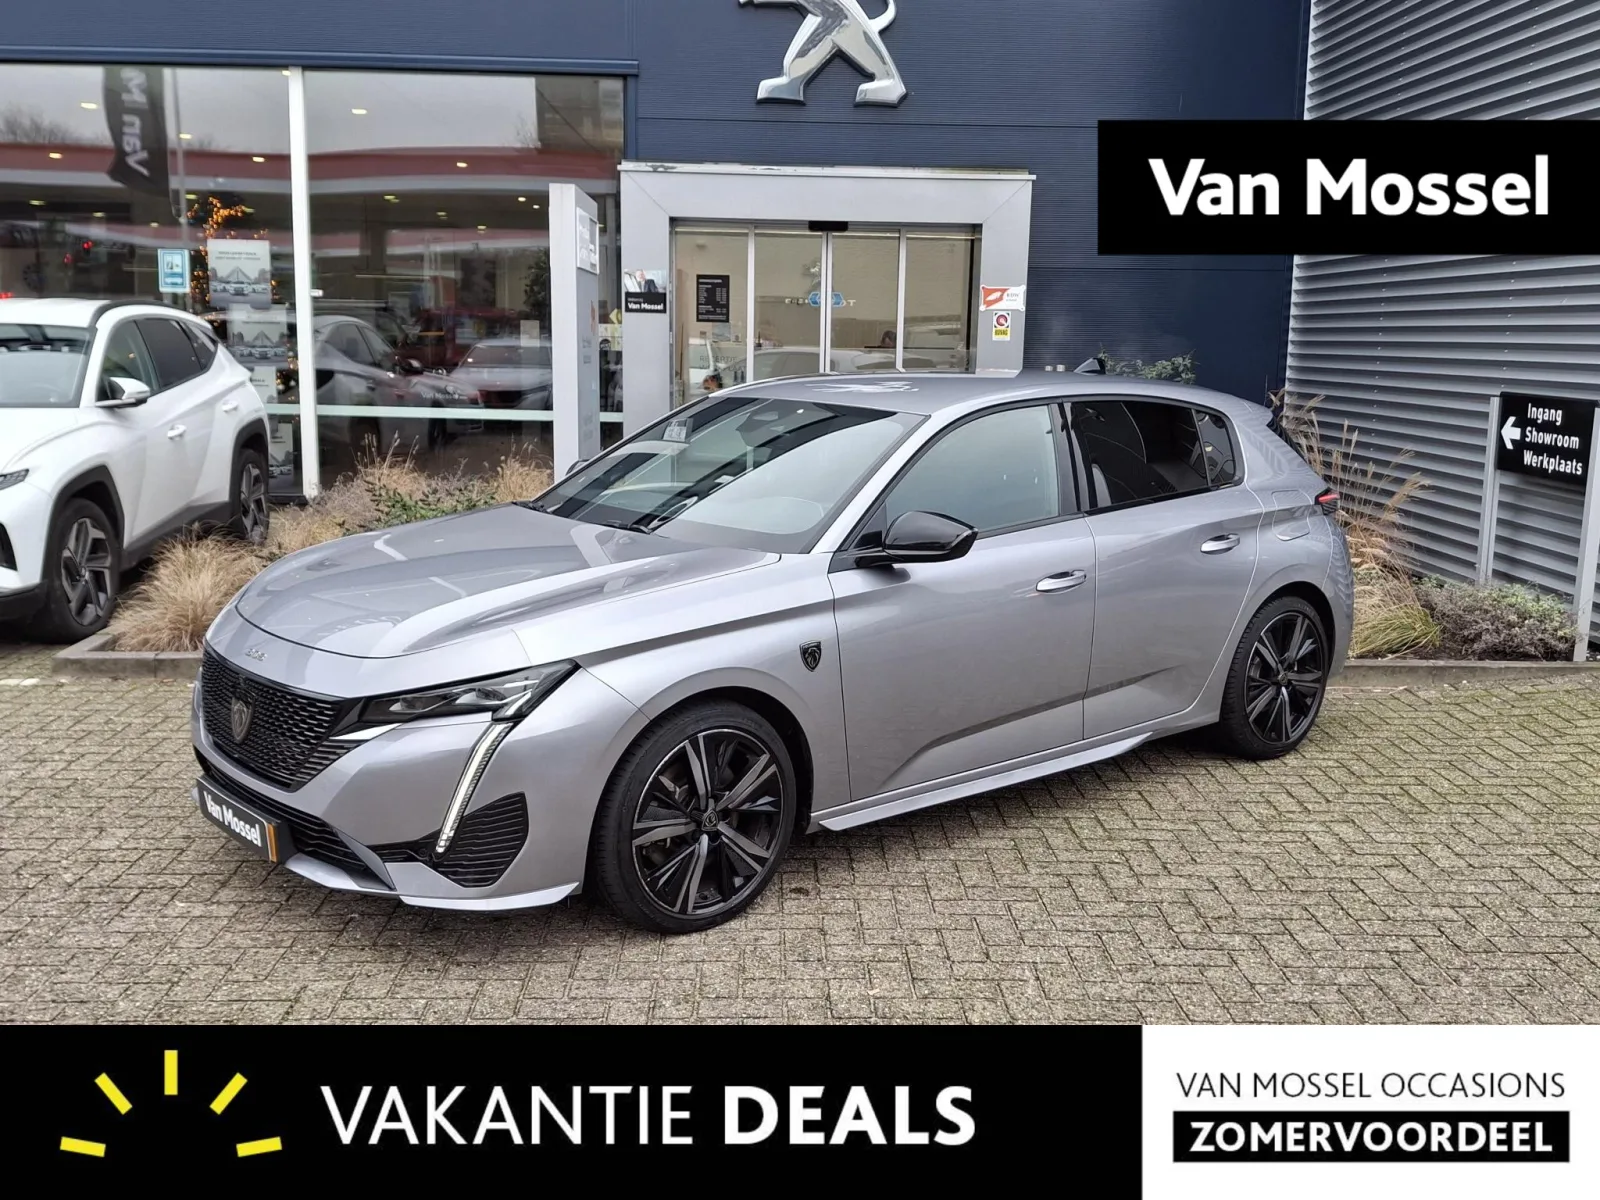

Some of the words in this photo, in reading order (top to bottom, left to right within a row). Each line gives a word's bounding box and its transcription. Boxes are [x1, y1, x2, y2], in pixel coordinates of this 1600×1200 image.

[627, 302, 640, 310] Van
[641, 302, 664, 310] Mossel
[1527, 402, 1563, 426] Ingang
[1524, 426, 1580, 450] Showroom
[1523, 449, 1583, 475] Werkplaats
[203, 791, 223, 822] Van
[222, 804, 262, 848] Mossel
